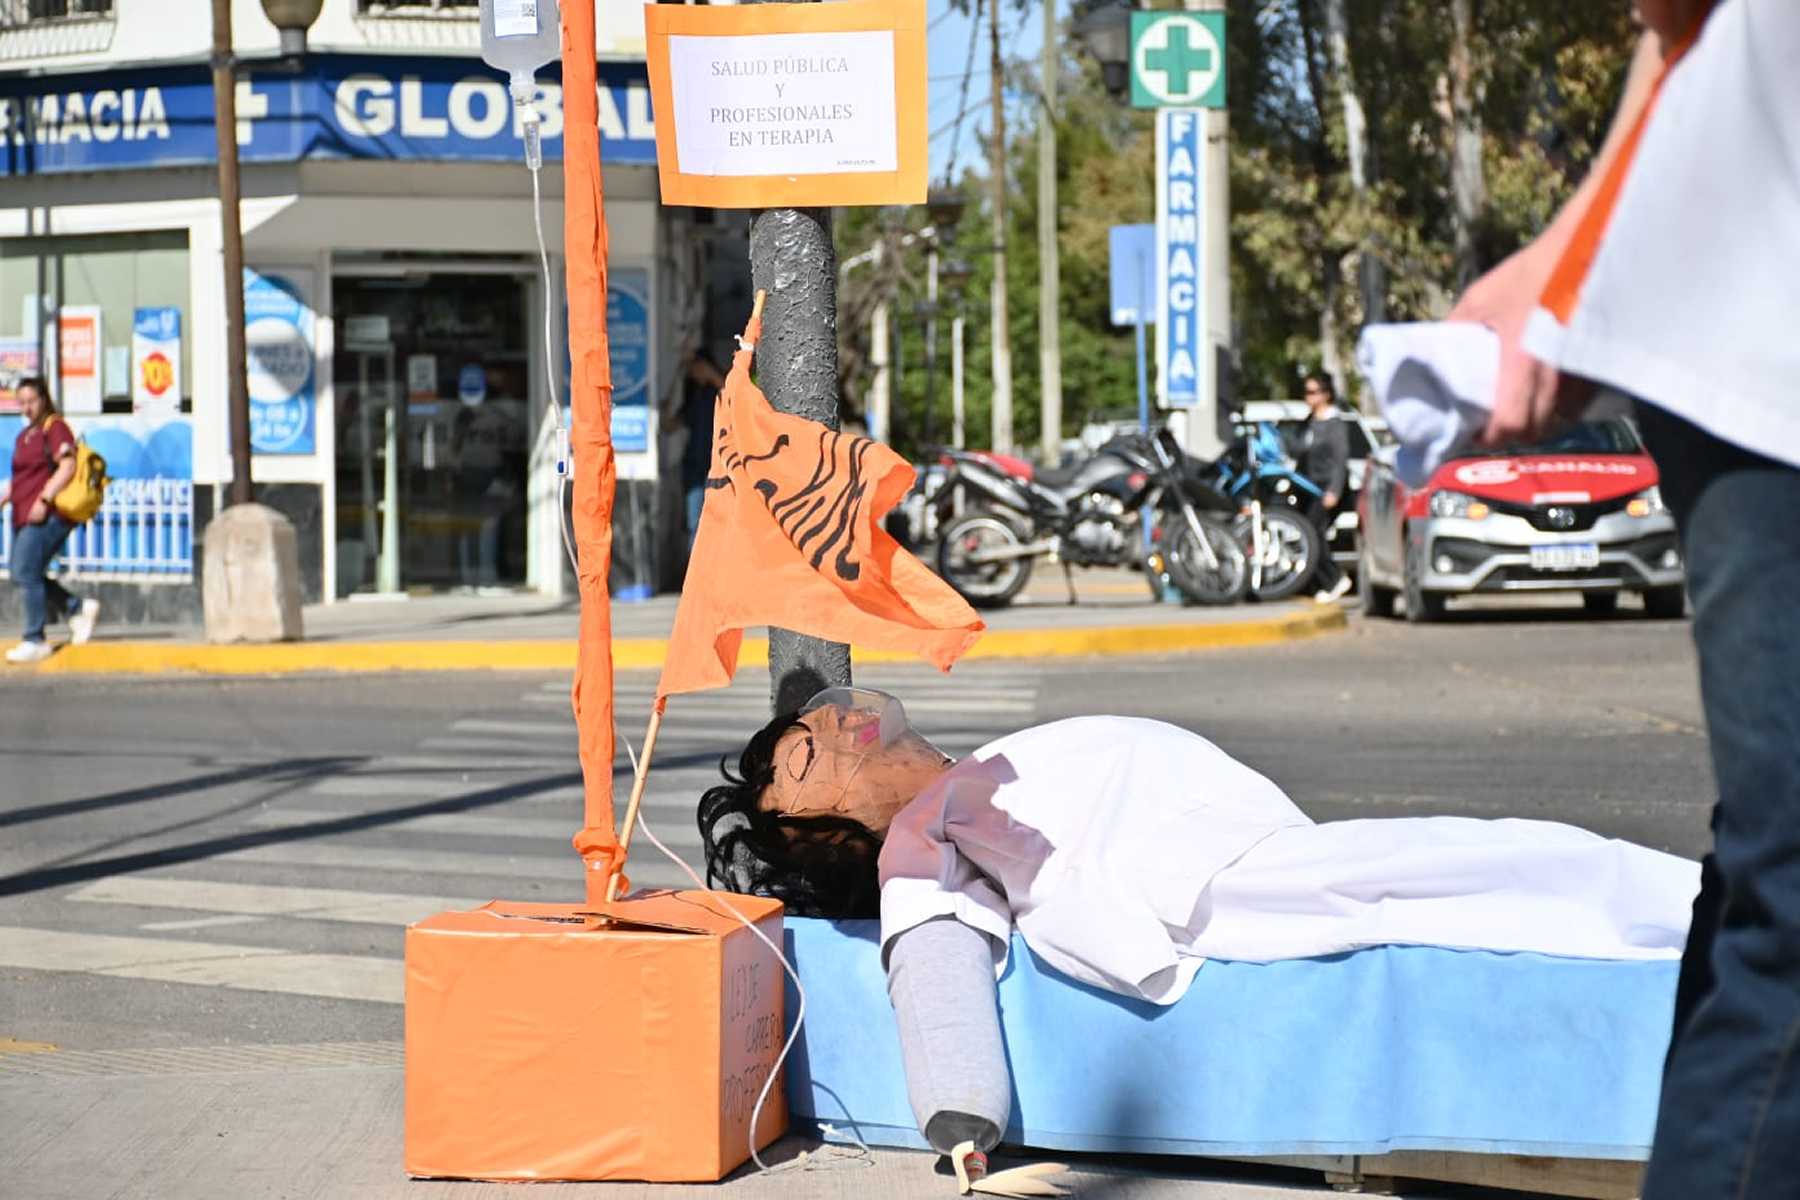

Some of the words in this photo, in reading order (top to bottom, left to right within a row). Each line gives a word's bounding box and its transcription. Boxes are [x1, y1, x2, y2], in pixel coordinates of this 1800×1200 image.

[711, 60, 768, 77] SALUD
[773, 55, 849, 76] PÚBLICA
[775, 82, 786, 99] Y
[710, 103, 853, 124] PROFESIONALES
[729, 130, 753, 147] EN
[757, 127, 834, 146] TERAPIA
[1167, 114, 1196, 381] FARMACIA
